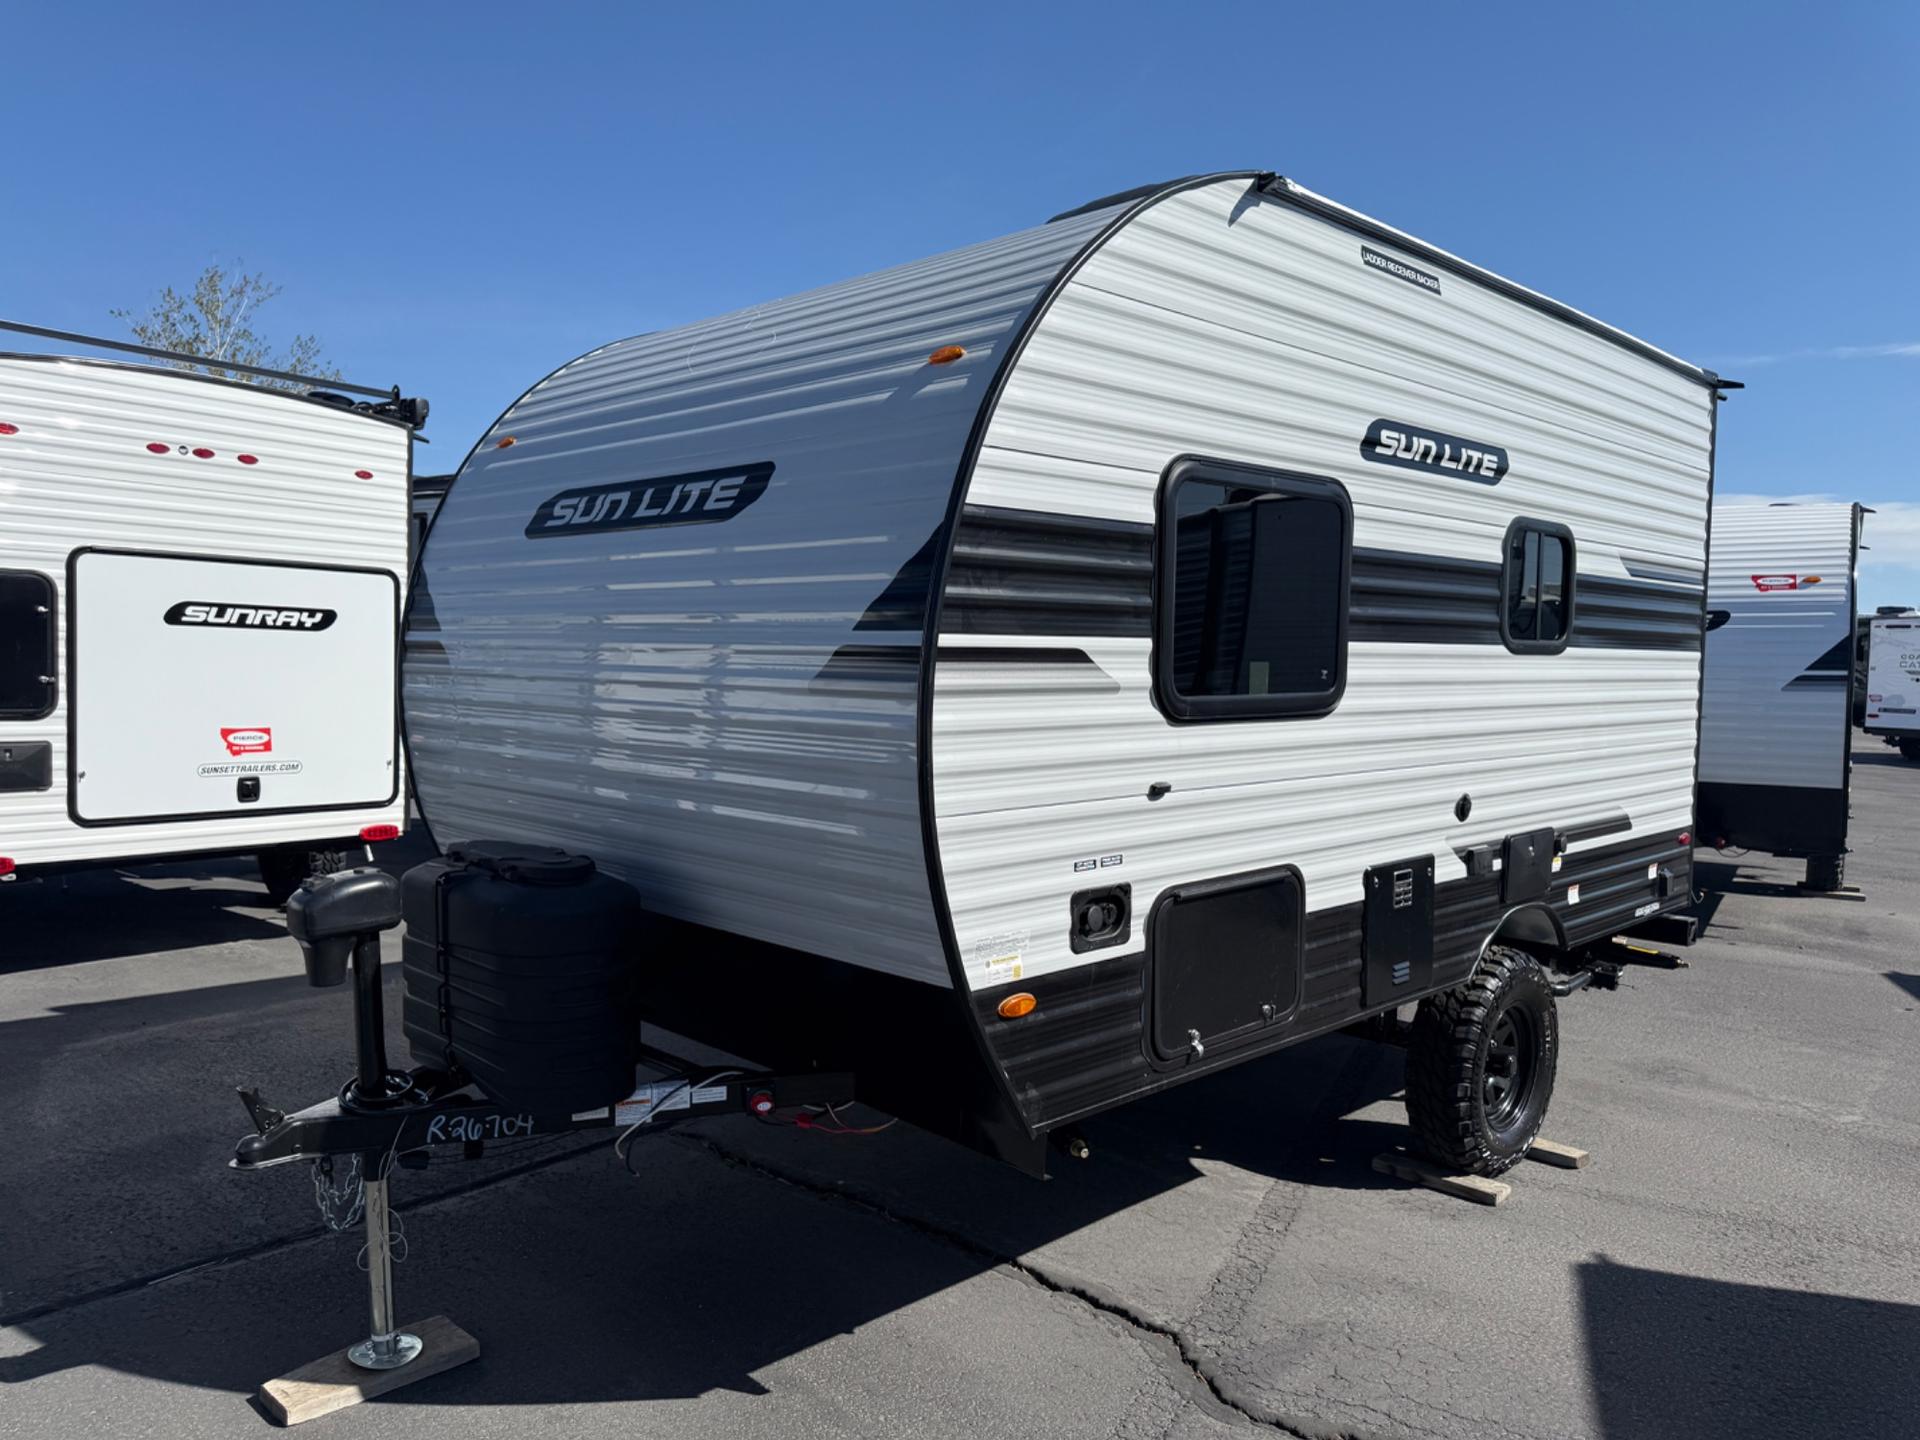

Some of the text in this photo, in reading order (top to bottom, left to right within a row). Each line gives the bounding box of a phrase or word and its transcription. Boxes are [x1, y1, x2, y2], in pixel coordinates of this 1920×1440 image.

[1362, 249, 1387, 268] LADDER
[1374, 428, 1498, 477] SUN LITE
[544, 475, 750, 527] SUN LITE
[181, 605, 323, 628] SUNRAY
